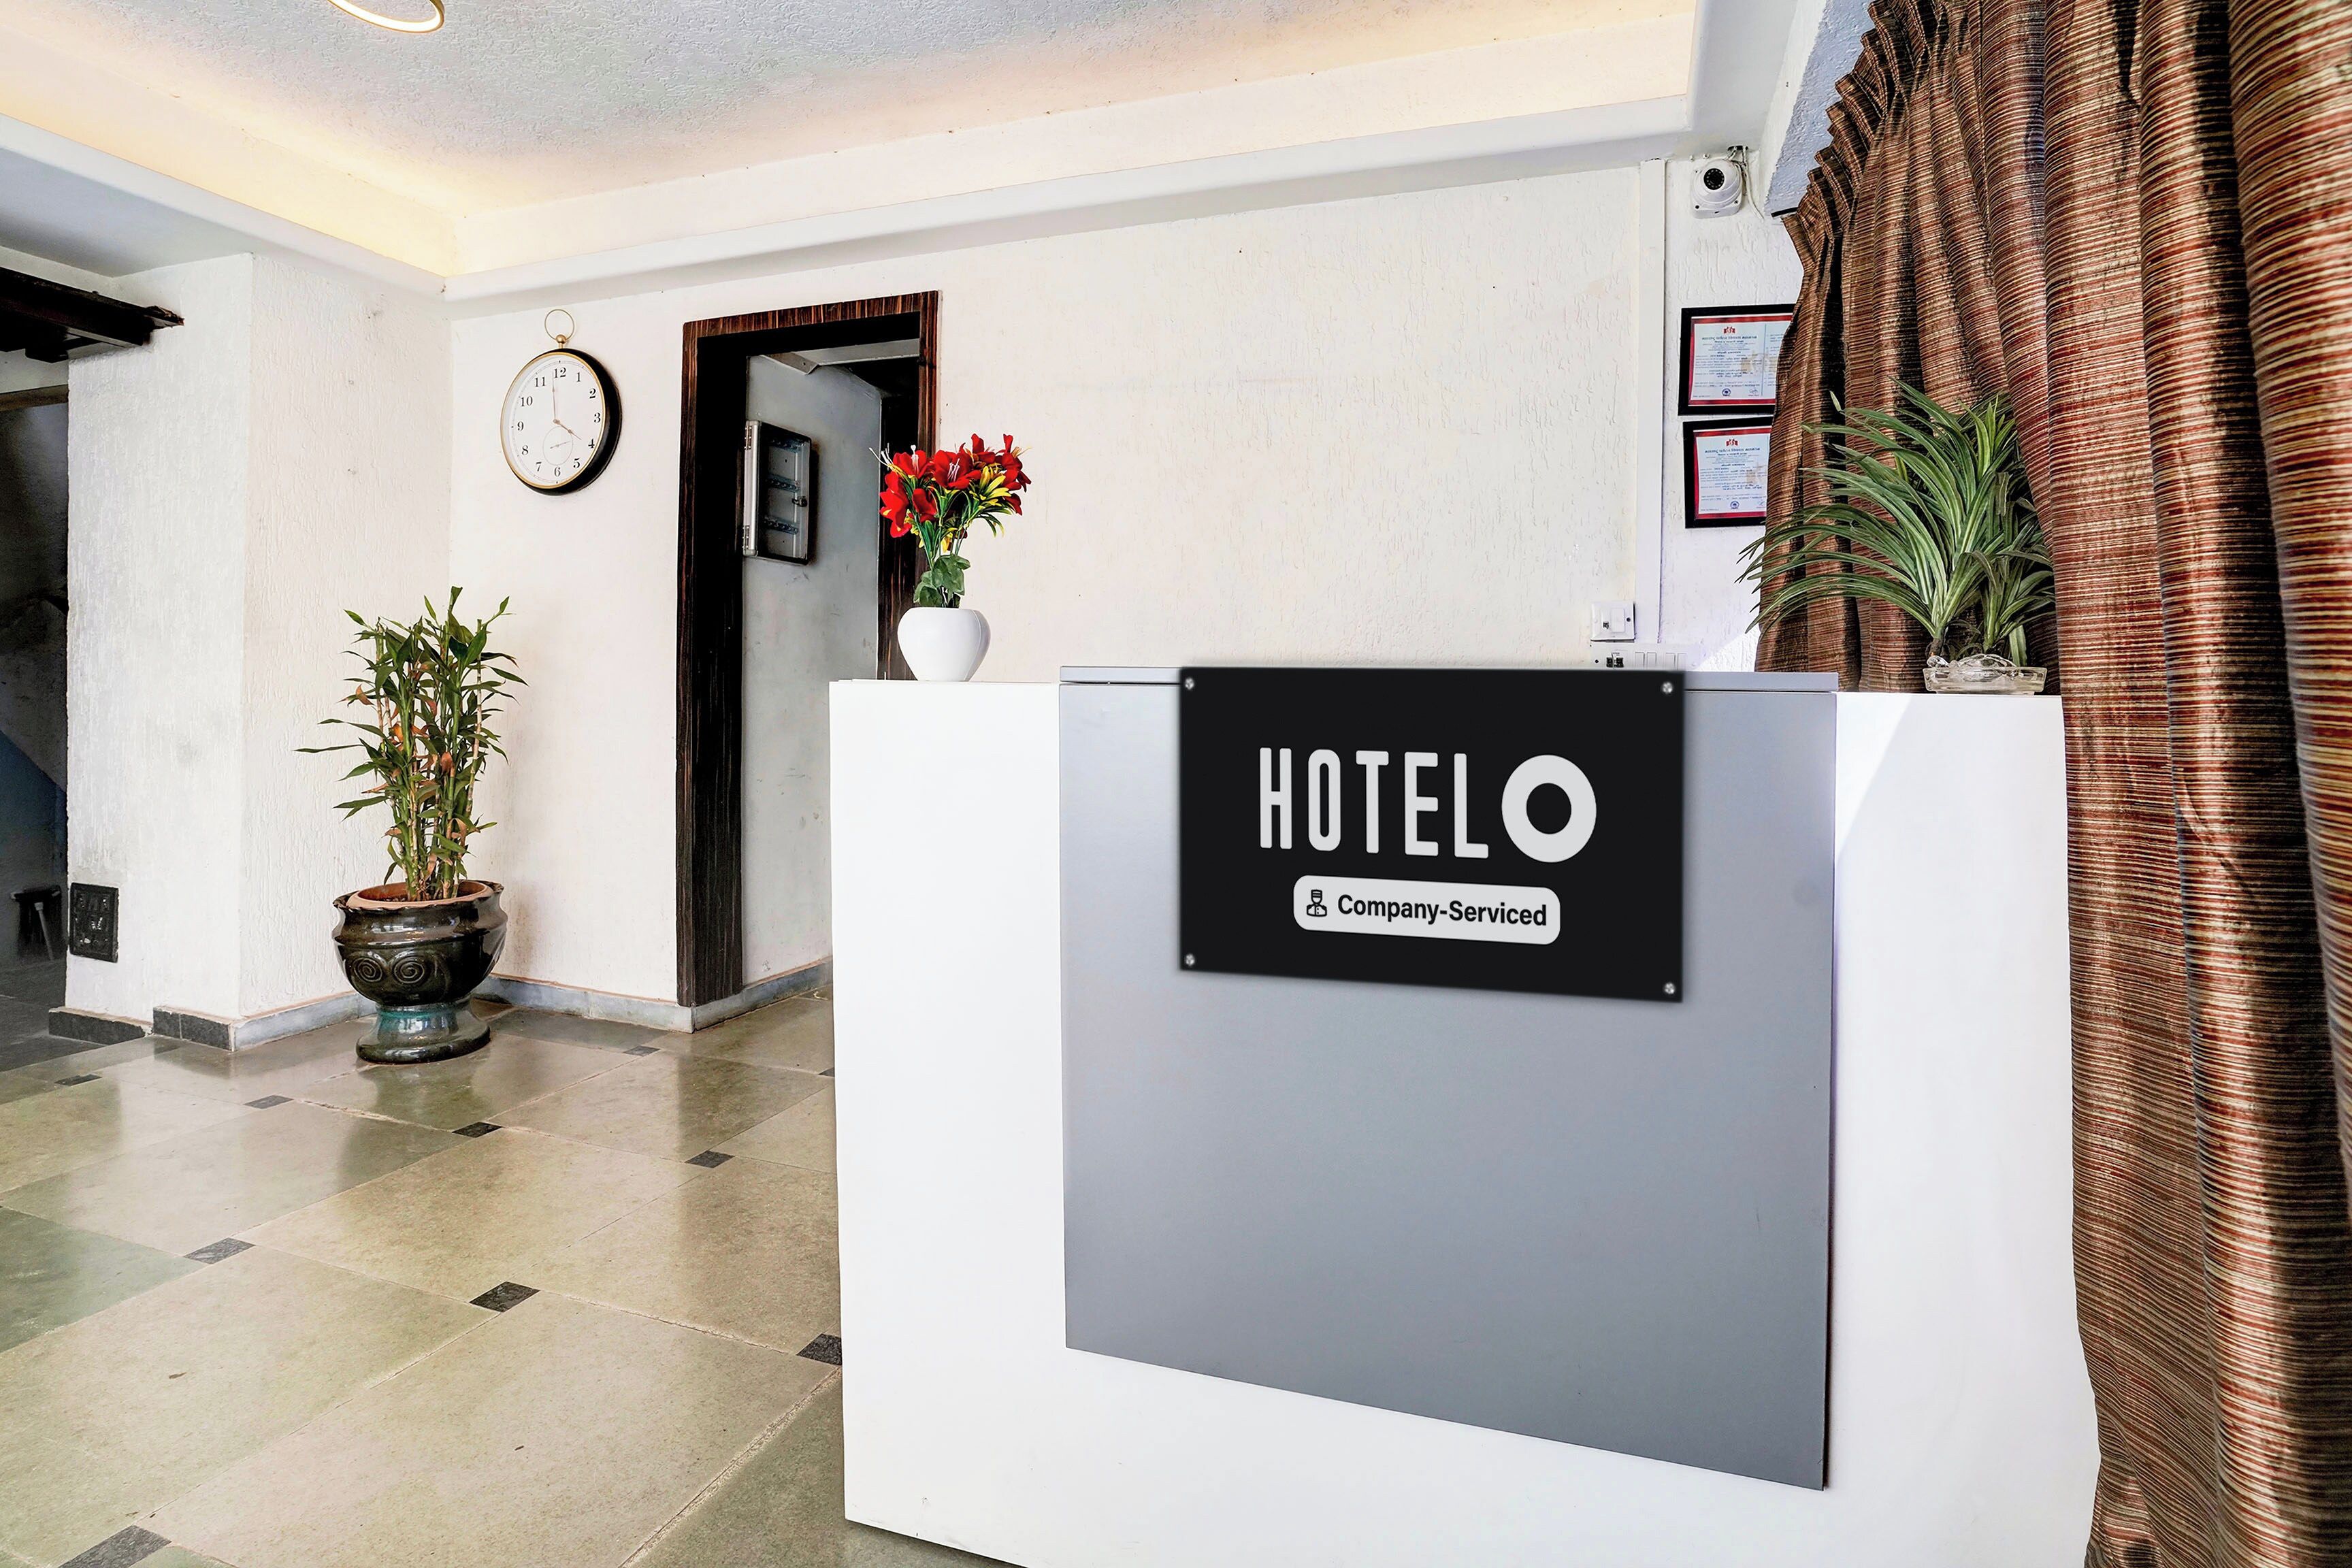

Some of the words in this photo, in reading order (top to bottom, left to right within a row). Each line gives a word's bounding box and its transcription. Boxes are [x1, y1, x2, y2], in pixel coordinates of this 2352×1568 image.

[555, 368, 566, 378] 12
[576, 372, 581, 382] 1
[536, 377, 544, 387] 11
[589, 389, 596, 399] 2
[521, 397, 532, 406] 10
[594, 413, 600, 423] 3
[518, 422, 523, 430] 9
[588, 438, 595, 449] 4
[522, 446, 528, 455] 8
[536, 462, 541, 472] 7
[574, 458, 580, 468] 5
[555, 468, 560, 476] 6
[1338, 894, 1547, 926] Company-Serviced
